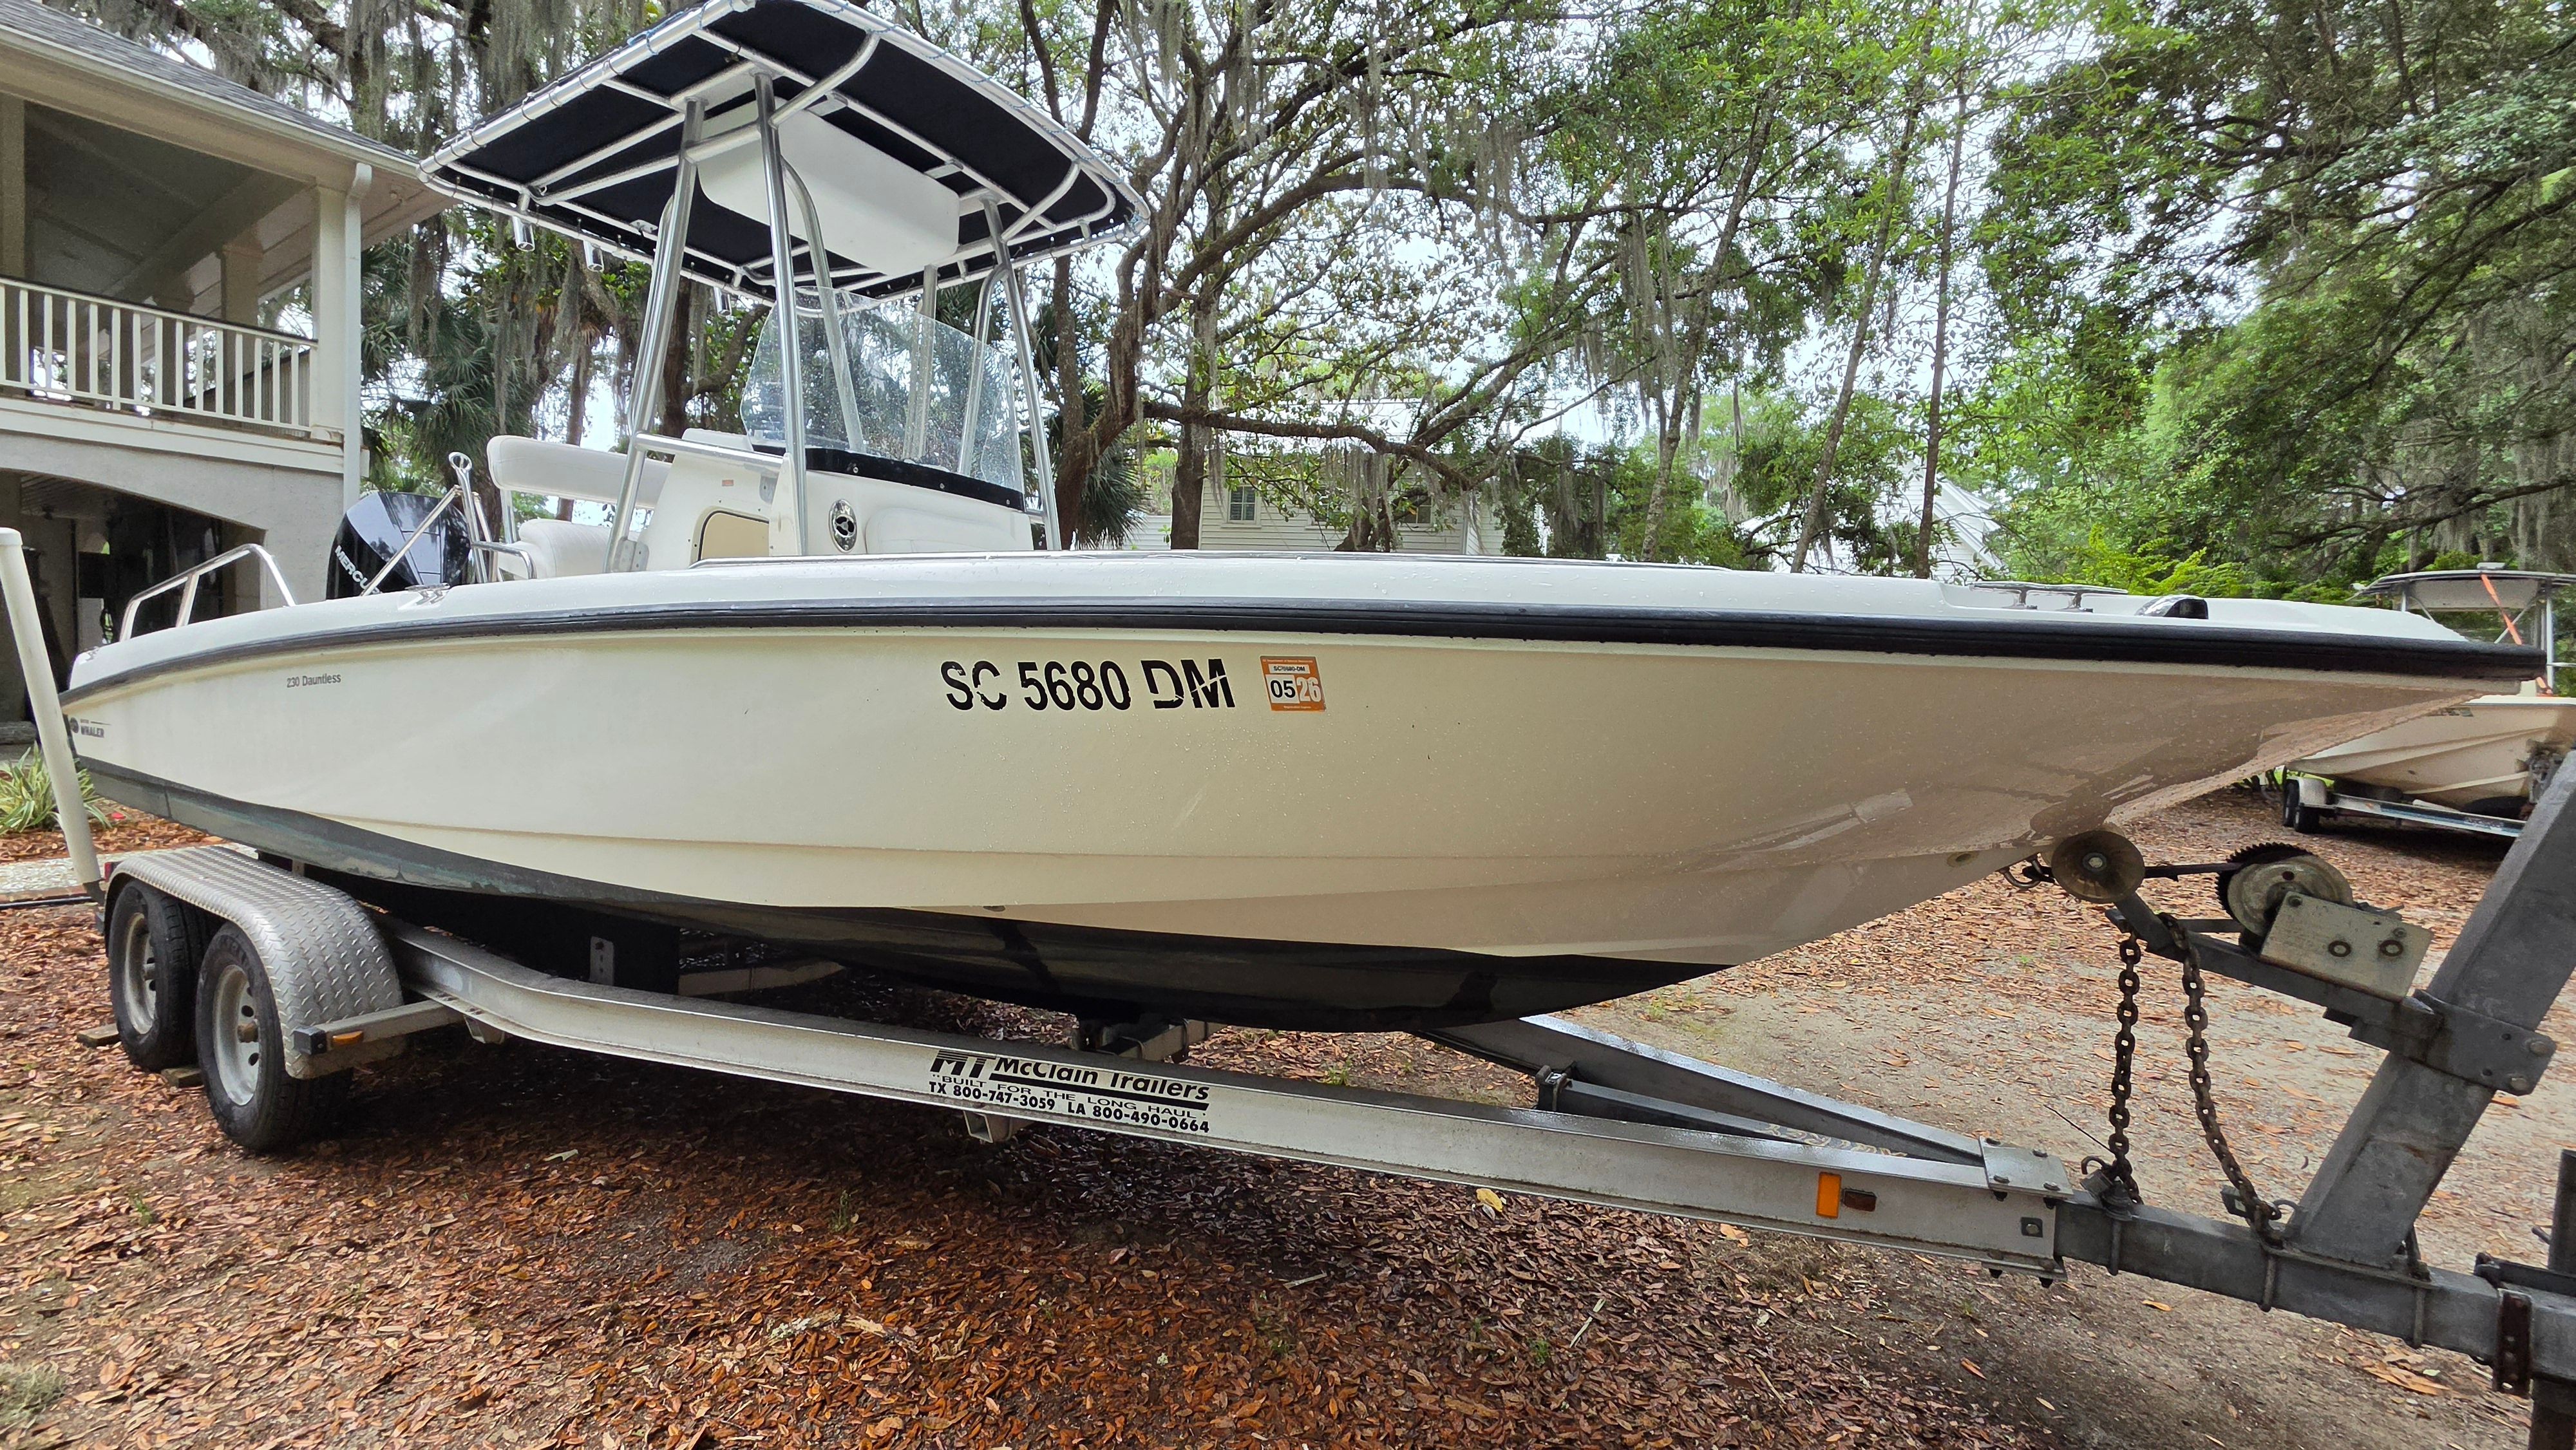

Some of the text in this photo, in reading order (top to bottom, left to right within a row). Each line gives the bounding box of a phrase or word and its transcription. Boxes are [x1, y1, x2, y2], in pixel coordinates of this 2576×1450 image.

[287, 673, 341, 688] 230 Dauntless
[940, 658, 1236, 711] SC 5680 DM
[1270, 677, 1321, 702] 05 26
[994, 1057, 1098, 1084] McClain
[1110, 1073, 1209, 1100] Trailers
[929, 1081, 1209, 1133] TX 800-747-3059 LA 800-490-0664
[998, 1084, 1031, 1095] FOR
[1043, 1090, 1076, 1101] THE
[1088, 1097, 1137, 1110] LONG
